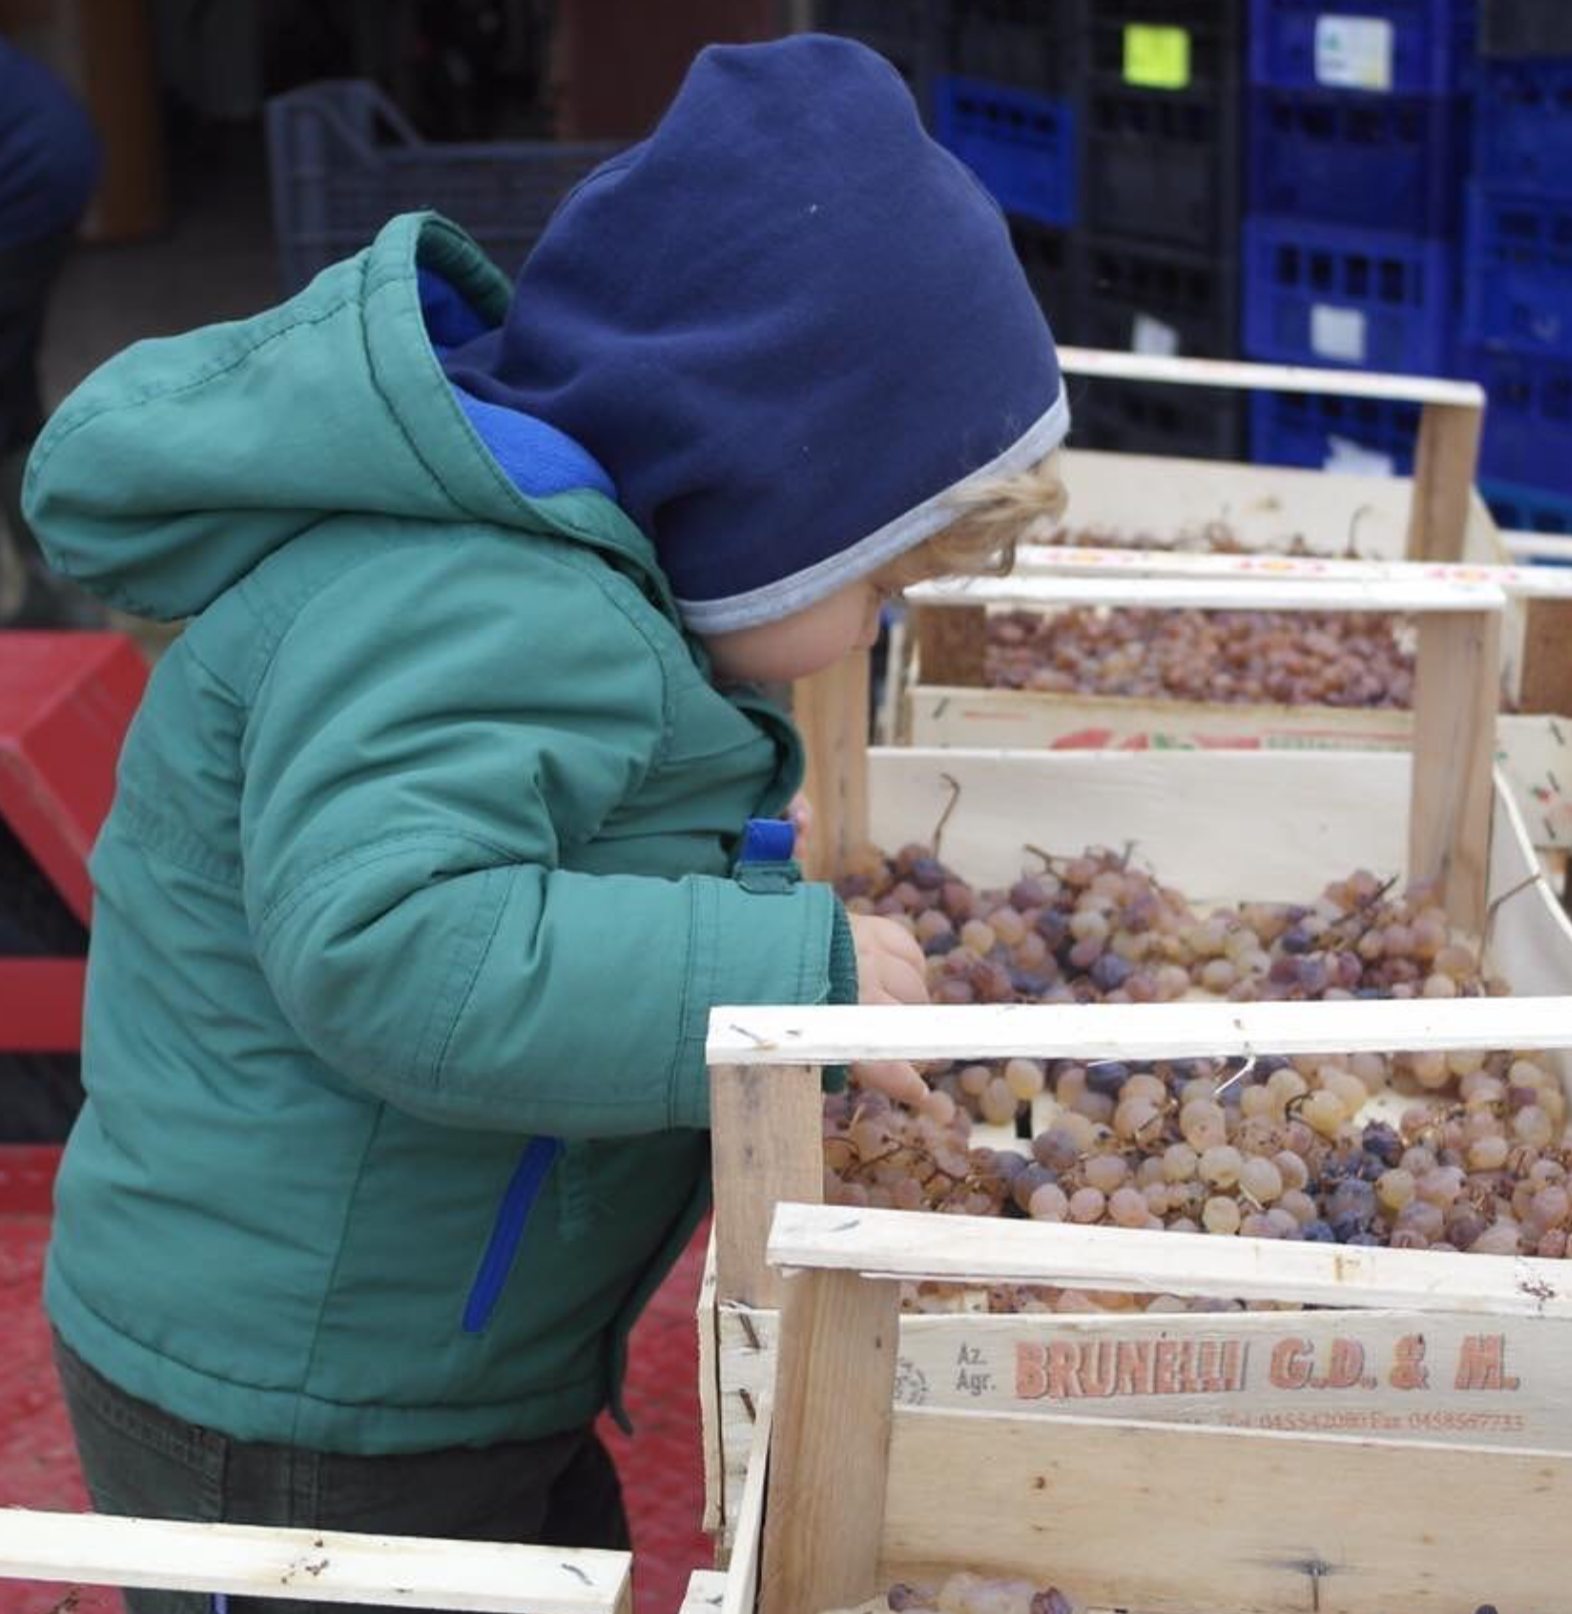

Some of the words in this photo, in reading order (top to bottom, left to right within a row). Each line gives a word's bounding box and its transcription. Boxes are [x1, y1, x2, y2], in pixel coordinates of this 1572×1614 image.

[957, 1341, 988, 1365] Az.
[1014, 1339, 1250, 1399] BRUNELLI
[1389, 1334, 1431, 1390] &
[1454, 1333, 1521, 1390] M.
[956, 1370, 997, 1396] Agr.
